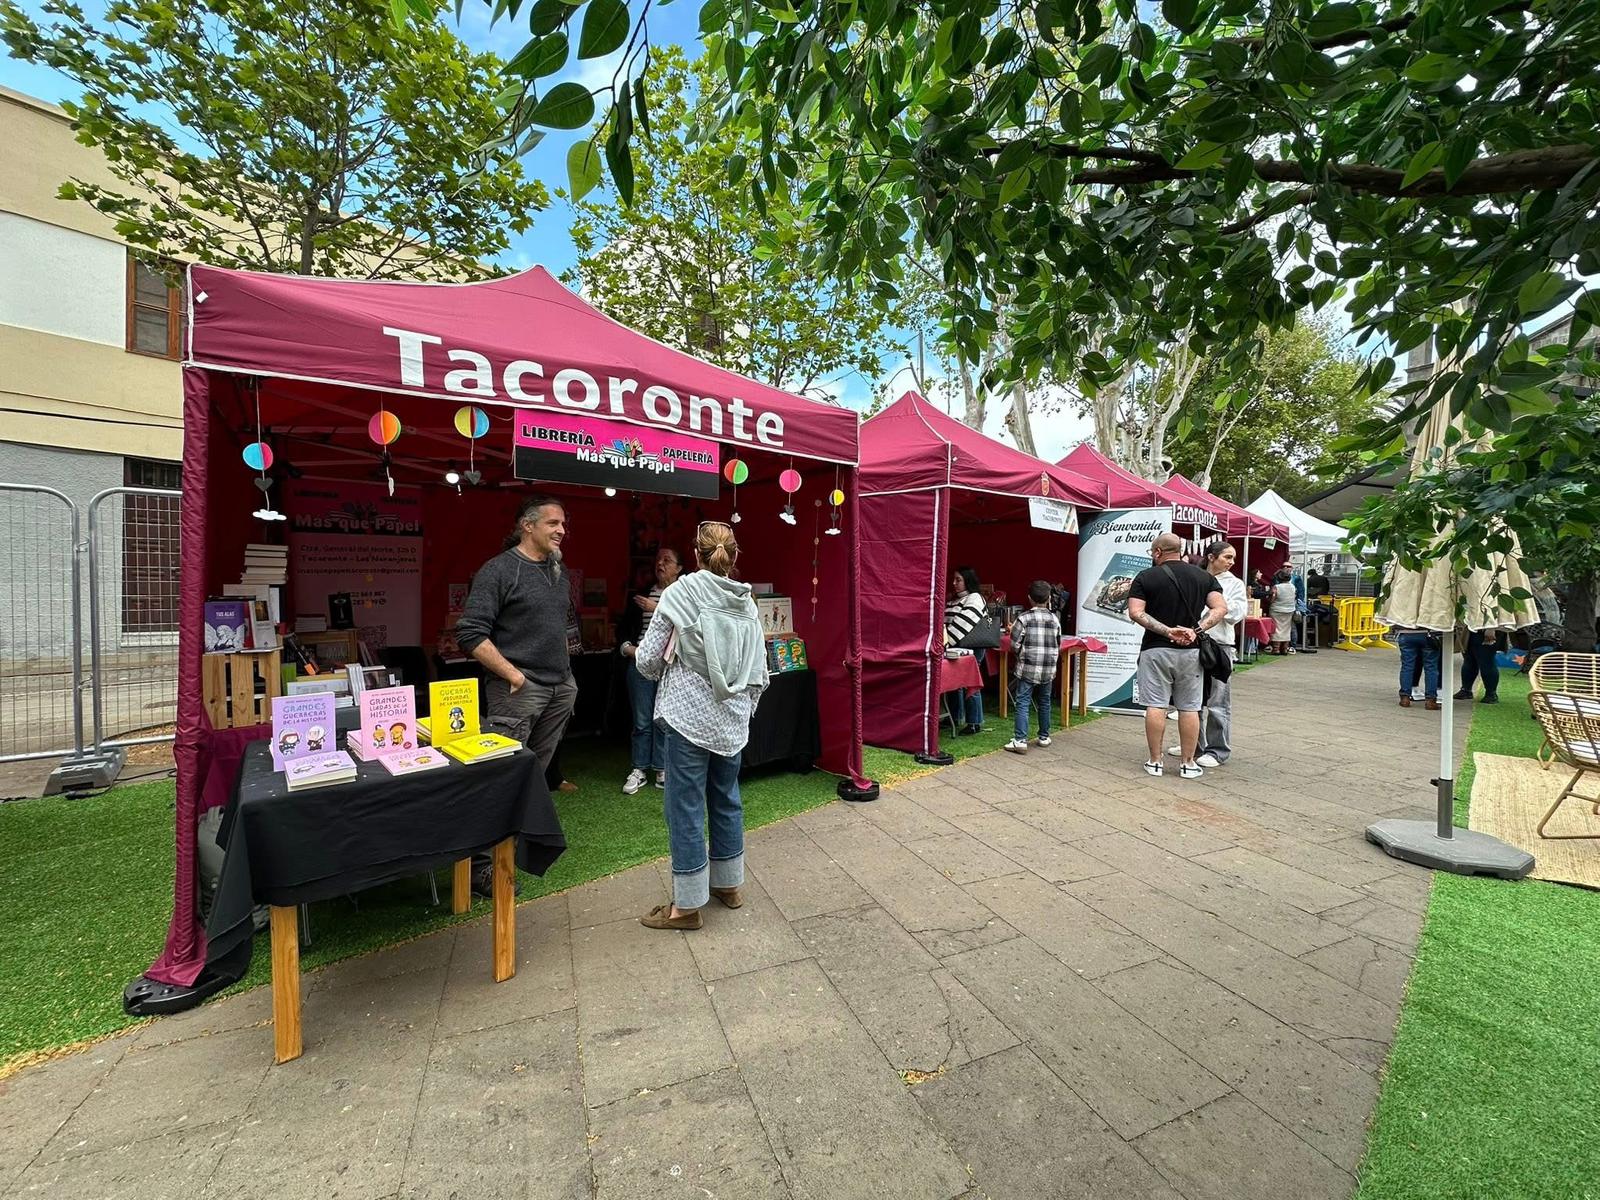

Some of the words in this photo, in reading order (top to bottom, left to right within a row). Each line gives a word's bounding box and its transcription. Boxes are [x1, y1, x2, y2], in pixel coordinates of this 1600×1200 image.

[383, 325, 784, 447] Tacoronte
[522, 425, 595, 447] LIBRERÍA
[576, 447, 605, 464] Más
[610, 454, 635, 469] que
[638, 458, 675, 474] Papel
[663, 447, 714, 465] PAPELERÍA
[1171, 501, 1218, 528] Tacoronte
[338, 518, 369, 533] que
[375, 517, 420, 534] Papel
[1114, 535, 1123, 543] a
[283, 703, 326, 713] GRANDES
[370, 696, 407, 705] GRANDES
[370, 708, 407, 718] HISTORIA
